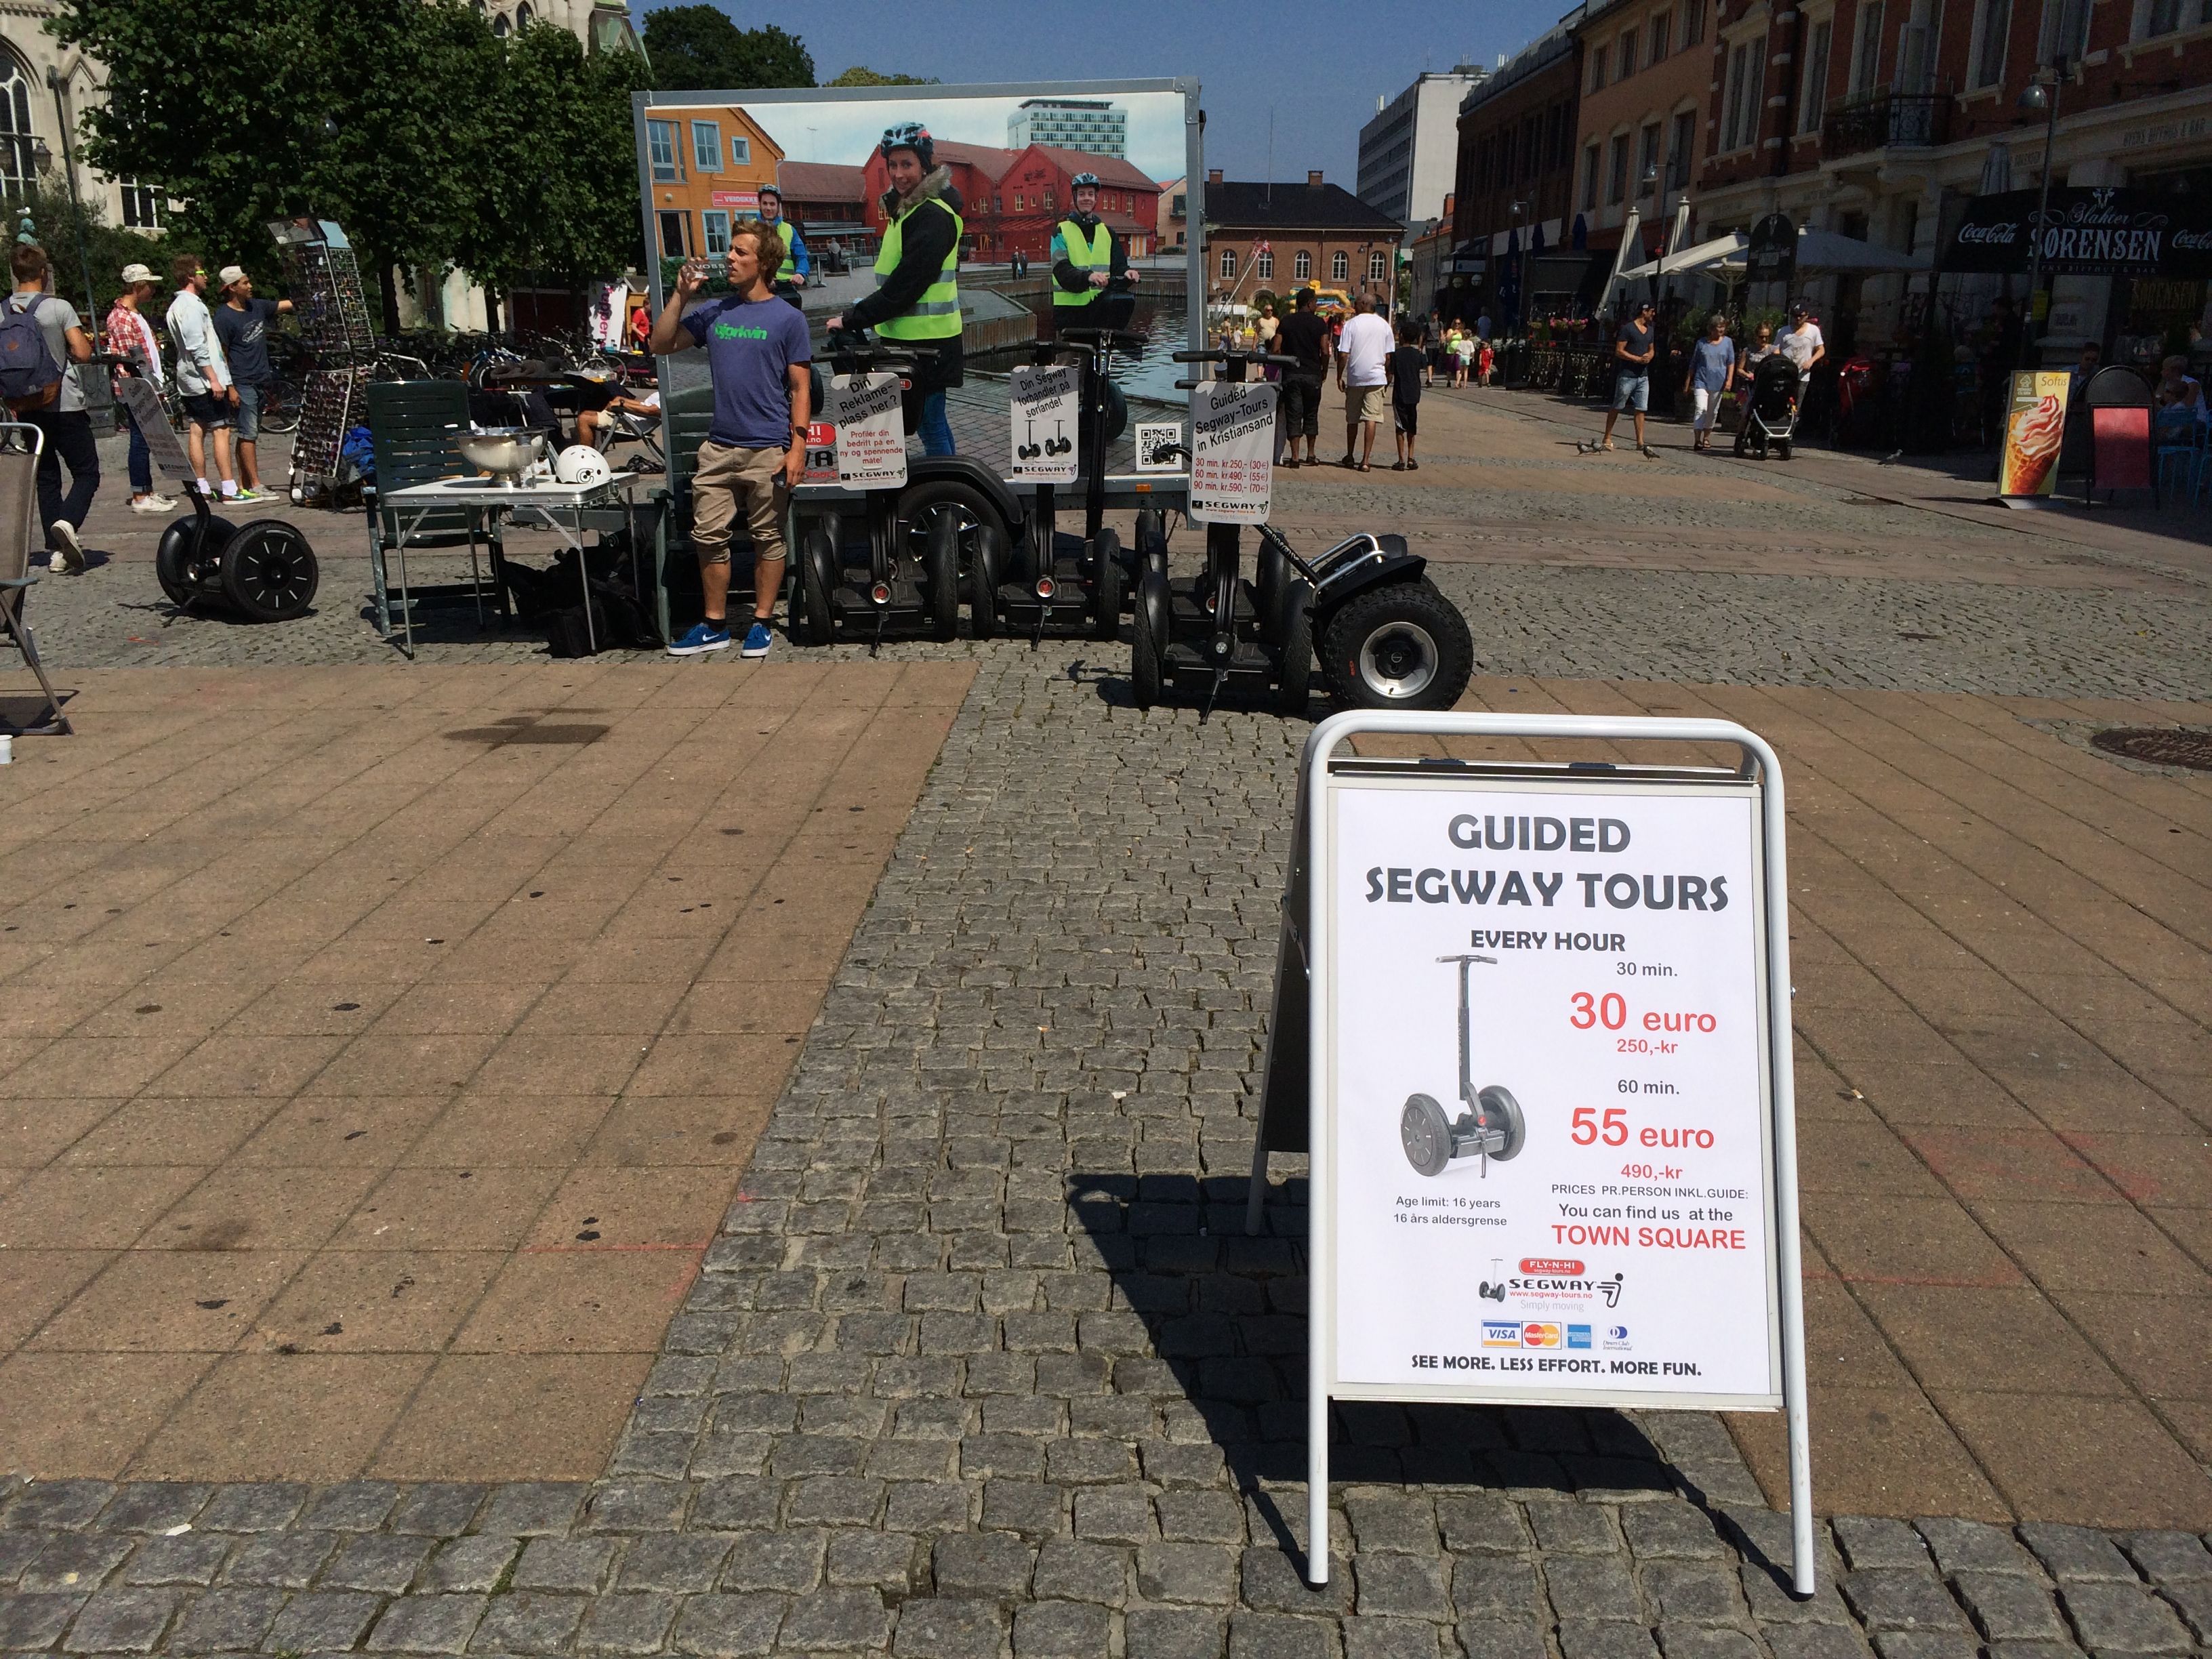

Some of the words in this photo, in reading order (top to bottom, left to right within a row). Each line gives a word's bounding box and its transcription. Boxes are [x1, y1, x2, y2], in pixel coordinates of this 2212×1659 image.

[849, 377, 872, 394] Din
[1020, 380, 1034, 392] Din
[1036, 367, 1067, 386] Segway
[2041, 376, 2068, 386] Softis
[840, 385, 893, 412] Reklame-
[1018, 385, 1057, 407] forhandler
[1210, 386, 1248, 411] Guided
[839, 411, 868, 430] plass
[870, 400, 888, 414] her
[890, 395, 897, 405] ?
[1195, 398, 1269, 434] Segway-Tours
[1197, 440, 1207, 452] in
[1209, 412, 1273, 447] Kristiansand
[847, 439, 871, 447] bedrift
[864, 447, 903, 456] spennende
[1195, 457, 1205, 467] 30
[1206, 458, 1218, 468] min.
[852, 470, 895, 478] SEGWAY
[1195, 469, 1204, 478] 60
[1206, 470, 1218, 479] min.
[1193, 480, 1203, 490] 90
[1205, 481, 1218, 491] min.
[1205, 501, 1256, 510] SEGWAY
[1448, 813, 1631, 853] GUIDED
[1365, 866, 1563, 907] SEGWAY
[1576, 872, 1729, 912] TOURS
[1471, 929, 1548, 949] EVERY
[1554, 932, 1626, 952] HOUR
[1616, 962, 1637, 976] 30
[1642, 962, 1678, 977] min.
[1570, 991, 1627, 1031] 30
[1643, 1012, 1717, 1033] euro
[1616, 1038, 1679, 1056] 250,-kr
[1618, 1079, 1639, 1094] 60
[1643, 1080, 1680, 1095] min.
[1571, 1107, 1629, 1147] 55
[1639, 1127, 1715, 1149] euro
[1620, 1164, 1683, 1181] 490,-kr
[1551, 1184, 1596, 1195] PRICES
[1601, 1185, 1671, 1197] PR.PERSON
[1675, 1187, 1748, 1200] INKL.GUIDE:
[1395, 1195, 1418, 1210] Age
[1421, 1196, 1450, 1208] limit:
[1452, 1197, 1467, 1208] 16
[1469, 1200, 1500, 1210] years
[1393, 1213, 1408, 1223] 16
[1410, 1212, 1429, 1224] års
[1431, 1214, 1507, 1227] aldersgrense
[1559, 1203, 1588, 1218] You
[1593, 1207, 1622, 1218] can
[1625, 1205, 1656, 1220] find
[1661, 1208, 1681, 1221] us
[1689, 1208, 1705, 1221] at
[1708, 1208, 1733, 1222] the
[1551, 1225, 1630, 1246] TOWN
[1638, 1227, 1746, 1250] SQUARE
[1529, 1261, 1576, 1269] FLY-N-HI
[1509, 1279, 1595, 1291] SEGWAY
[1509, 1290, 1593, 1299] www.segway-tours.no
[1520, 1299, 1551, 1311] Simply
[1552, 1303, 1584, 1313] moving
[1489, 1329, 1516, 1339] VISA
[1524, 1332, 1559, 1340] MasterCard
[1411, 1354, 1439, 1369] SEE
[1443, 1355, 1496, 1370] MORE.
[1500, 1357, 1534, 1372] LESS
[1538, 1358, 1606, 1374] EFFORT.
[1610, 1360, 1659, 1375] MORE
[1662, 1361, 1702, 1376] FUN.
